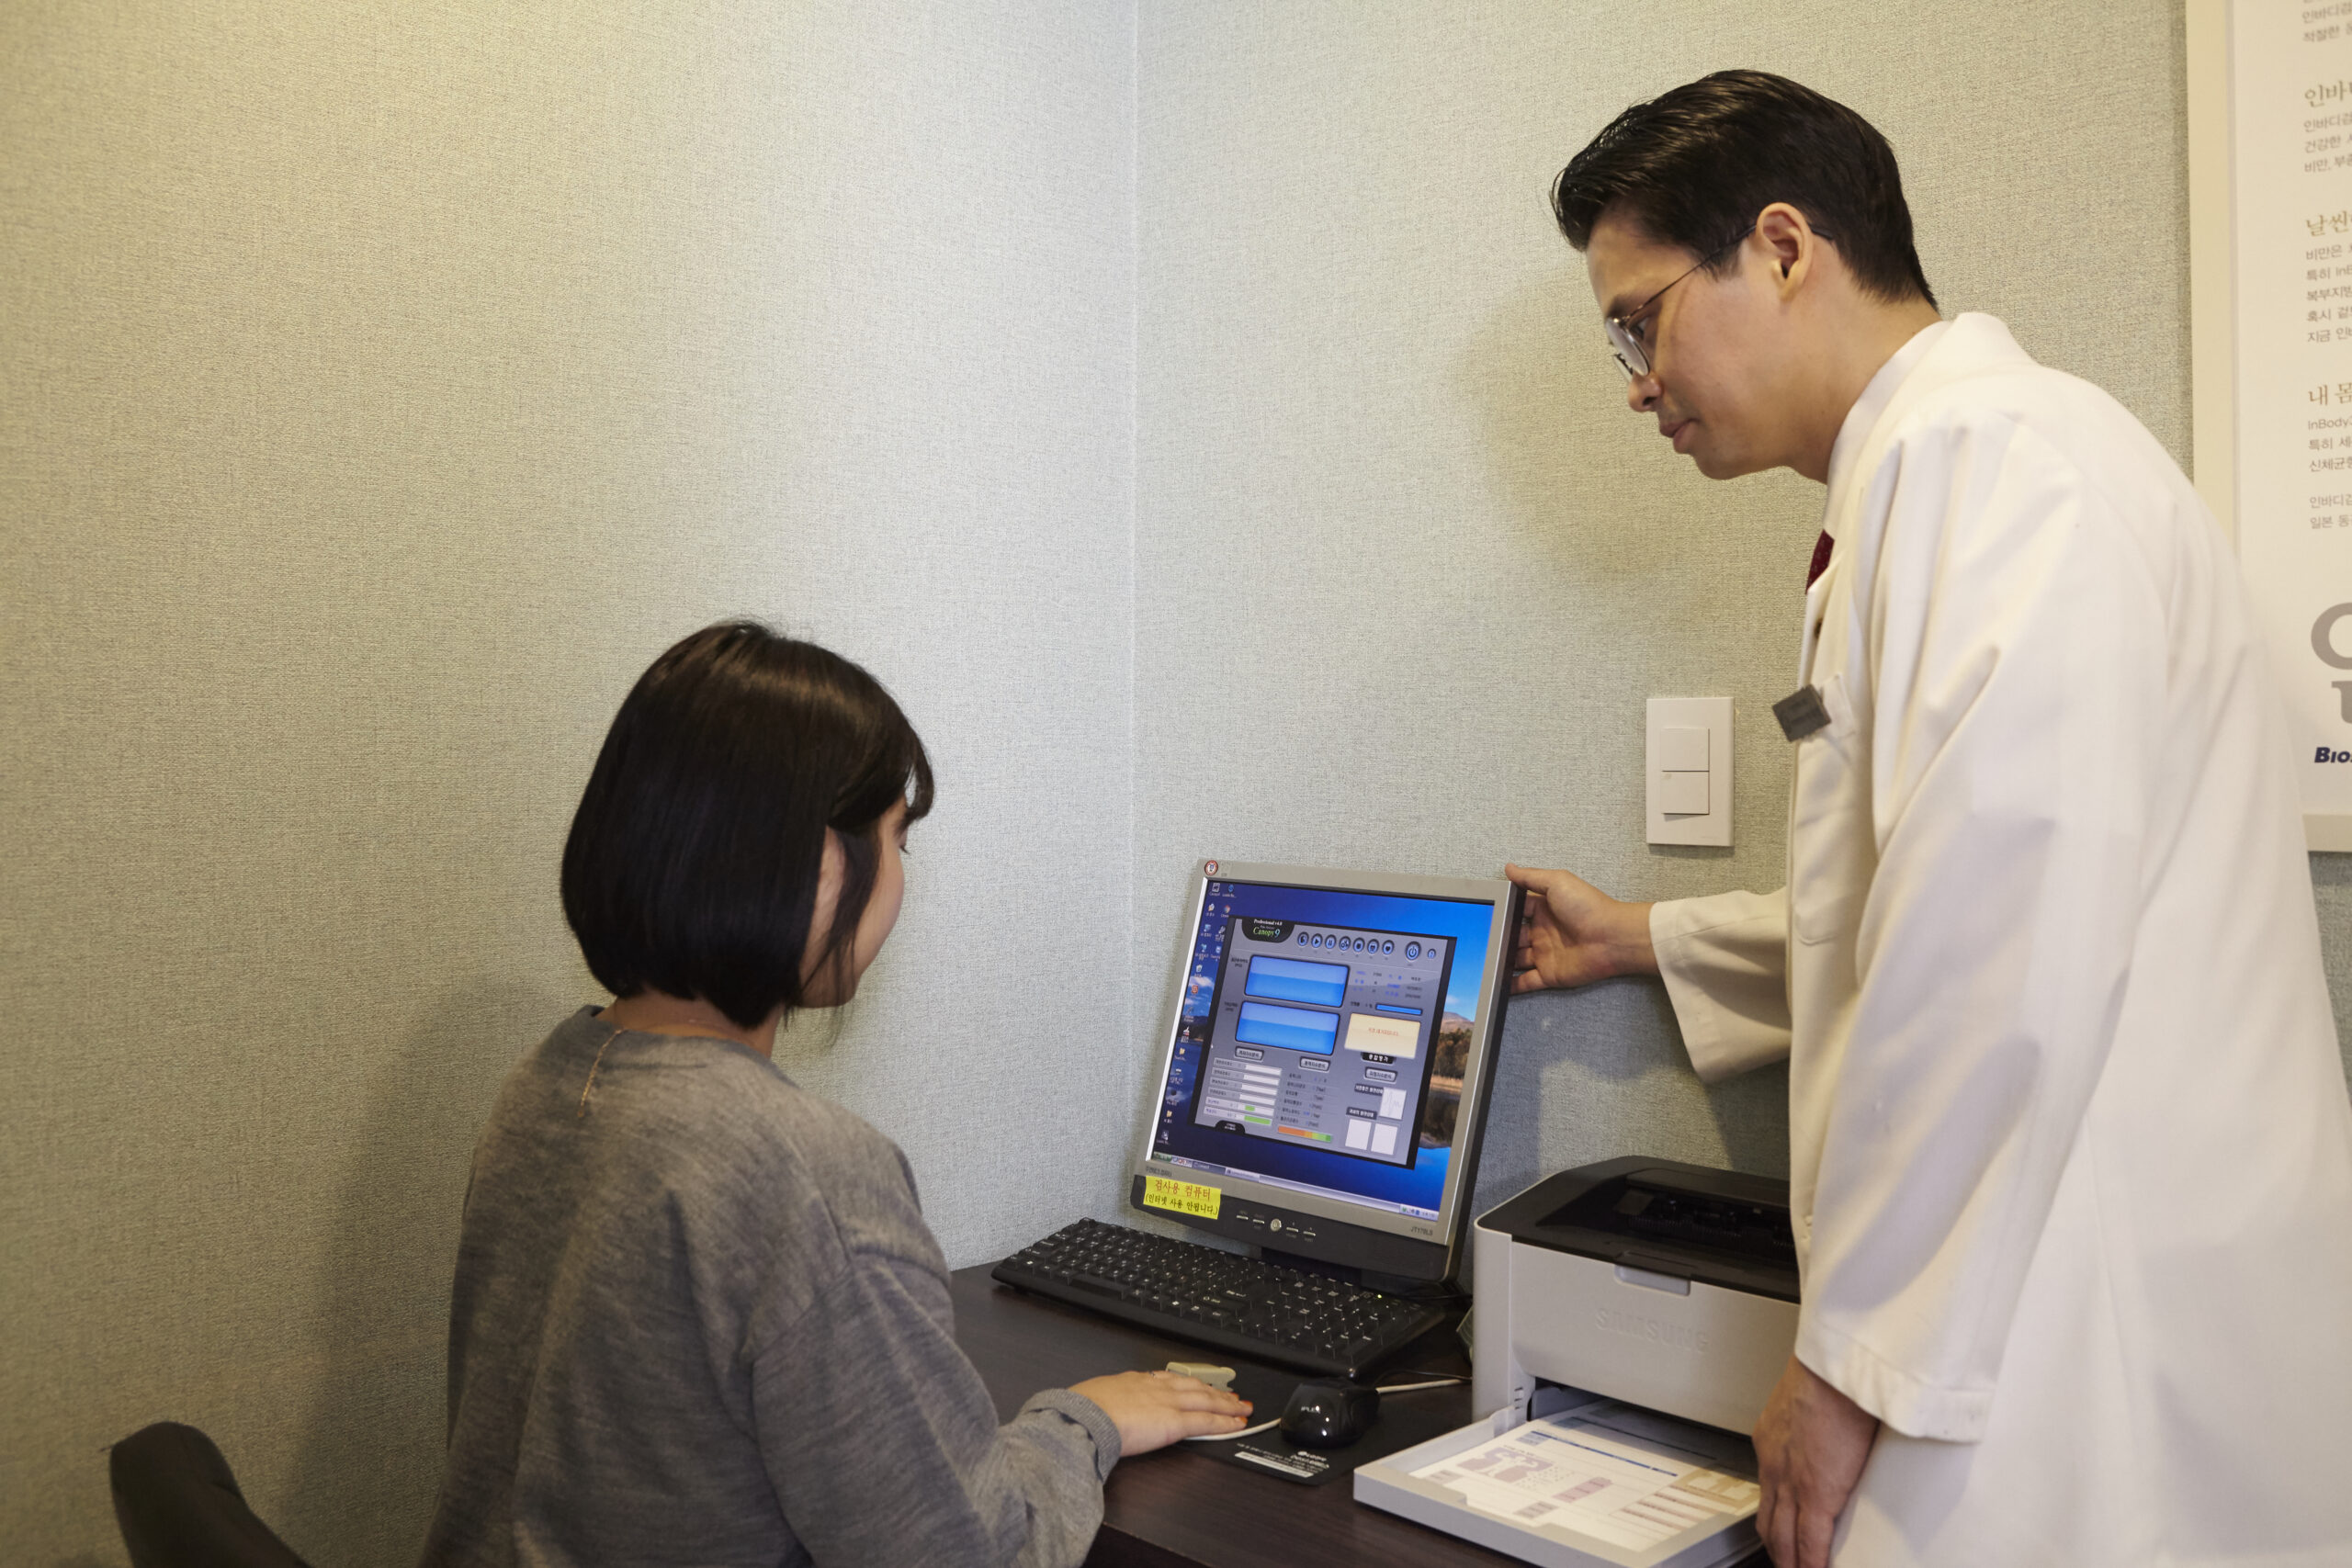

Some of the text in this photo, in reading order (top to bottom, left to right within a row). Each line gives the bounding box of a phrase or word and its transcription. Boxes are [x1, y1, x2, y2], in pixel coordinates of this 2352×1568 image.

[2304, 80, 2352, 107] 인바
[2307, 210, 2352, 237] 날씬
[2306, 244, 2343, 260] 비만은
[2307, 330, 2331, 343] 지금
[2308, 382, 2352, 406] 내 몸
[2308, 437, 2333, 451] 특히
[2310, 514, 2352, 529] 일본 동
[1155, 1179, 1211, 1201] 검사용 컴퓨터
[1145, 1193, 1168, 1206] (인터넷
[1170, 1198, 1183, 1209] 사용
